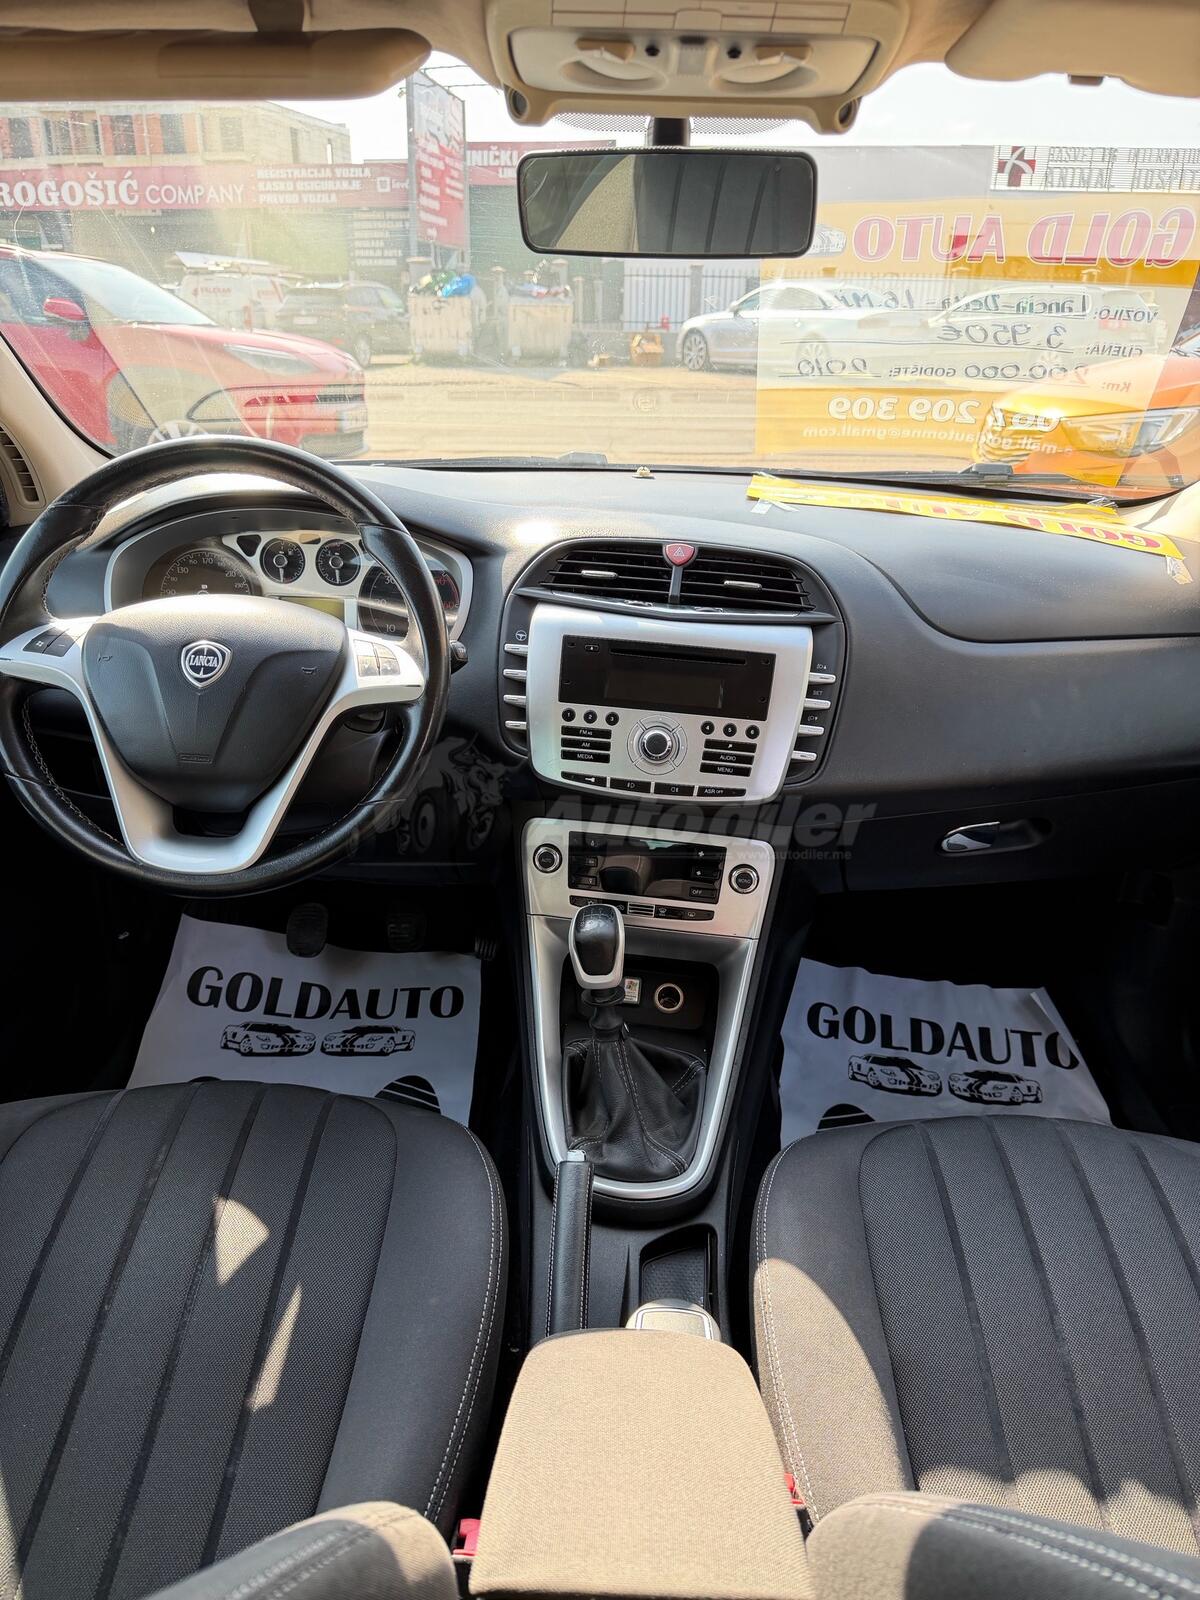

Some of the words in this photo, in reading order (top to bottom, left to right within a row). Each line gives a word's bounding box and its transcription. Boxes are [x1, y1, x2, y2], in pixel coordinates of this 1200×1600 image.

[1131, 168, 1200, 190] HOSPIT
[145, 184, 244, 205] COMPANY
[189, 654, 218, 668] LANCIA
[187, 966, 465, 1021] GOLDAUTO
[806, 1002, 1080, 1070] GOLDAUTO
